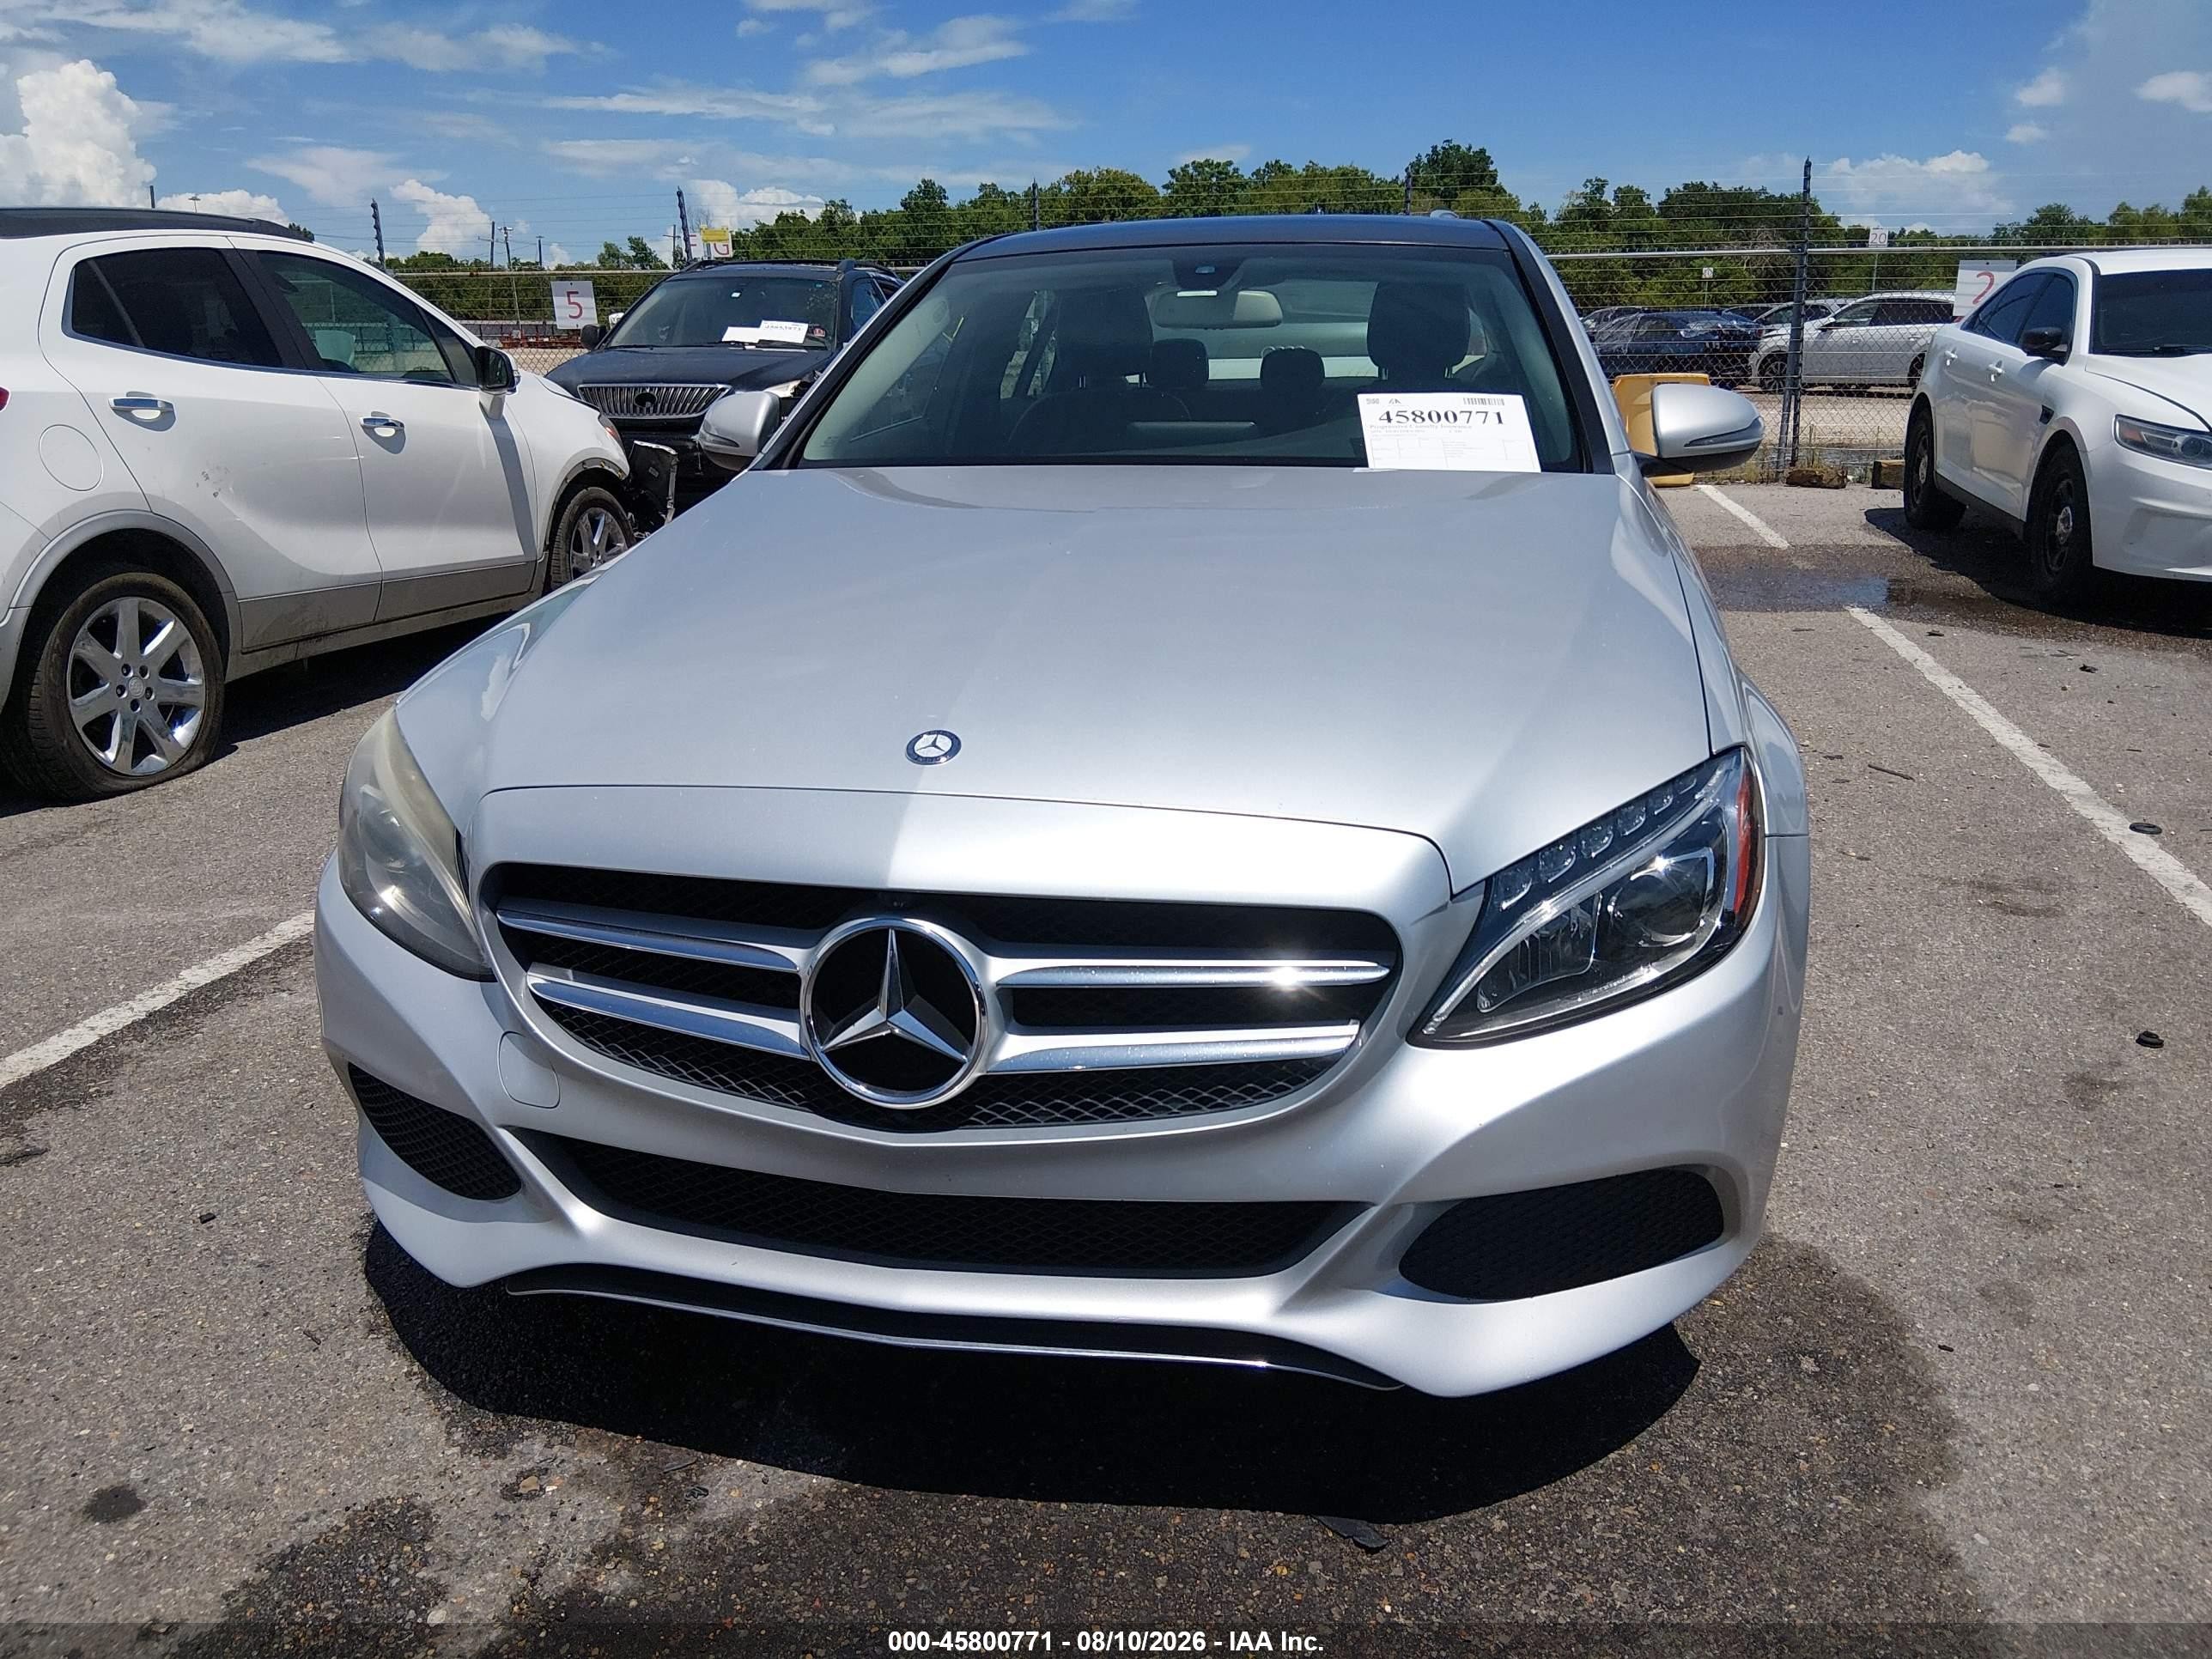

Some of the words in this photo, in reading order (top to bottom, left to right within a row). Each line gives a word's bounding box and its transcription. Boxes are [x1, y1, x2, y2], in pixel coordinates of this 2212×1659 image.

[1870, 233, 1887, 244] 20
[1972, 270, 1995, 305] 2
[567, 290, 583, 319] 5
[1378, 410, 1504, 424] 45800771
